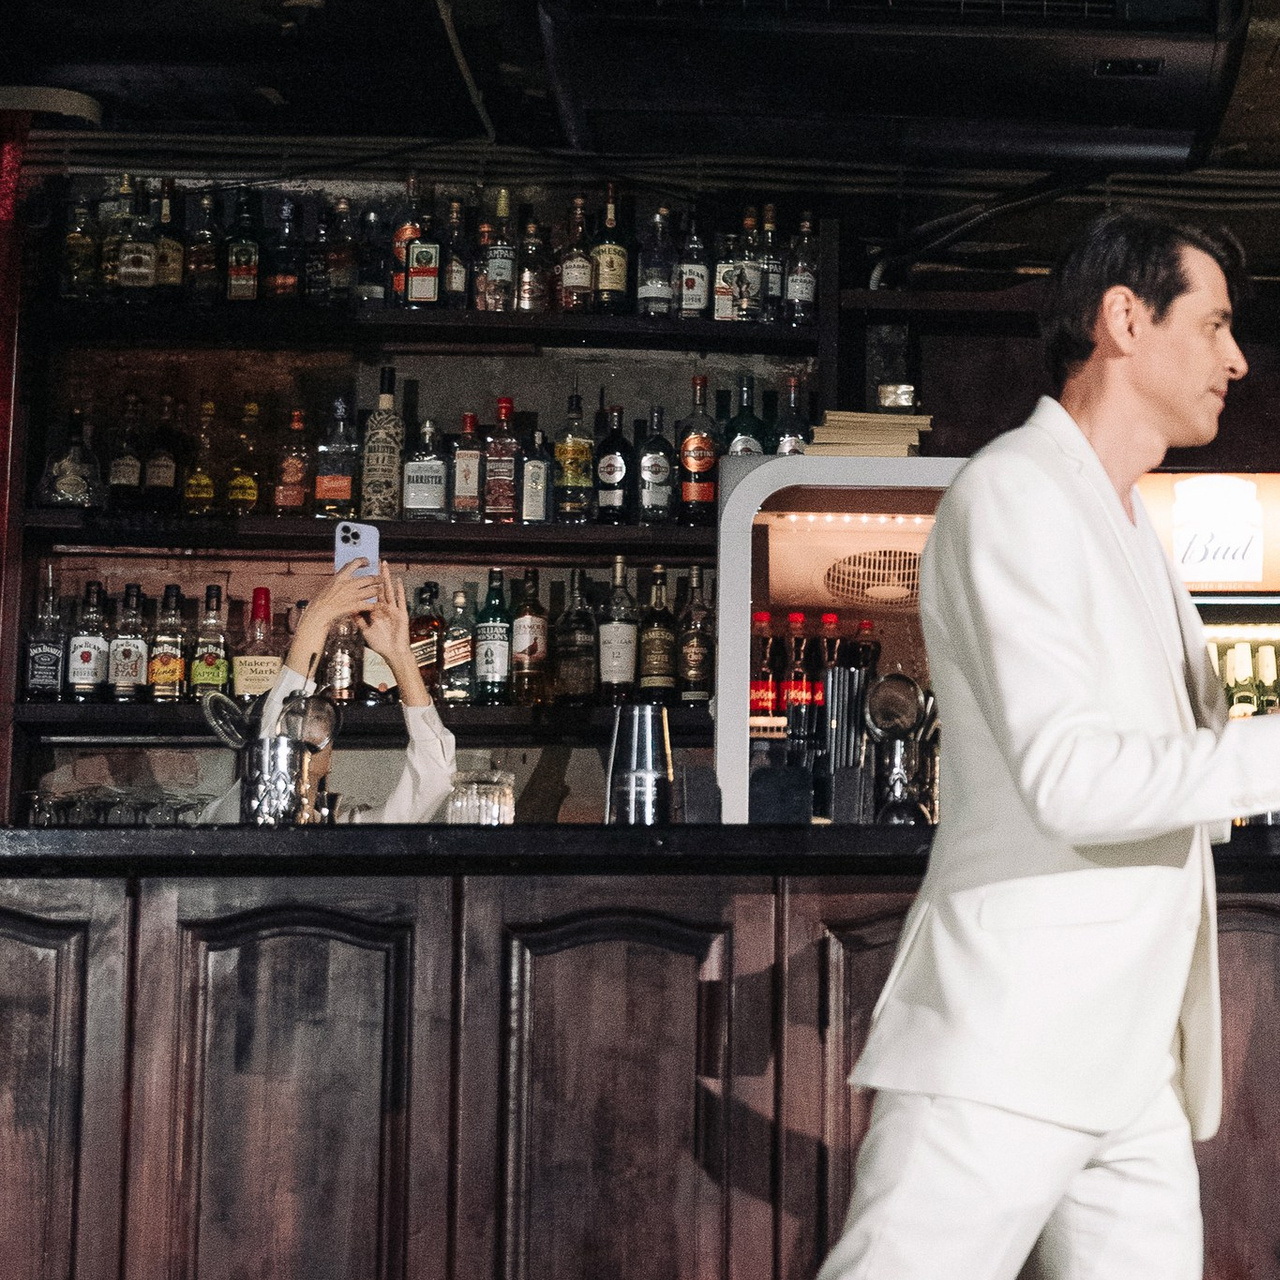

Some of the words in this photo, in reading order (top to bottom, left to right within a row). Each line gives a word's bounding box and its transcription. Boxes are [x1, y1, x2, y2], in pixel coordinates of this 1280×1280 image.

[407, 474, 442, 485] BARRISTER
[1180, 531, 1254, 564] Bud
[641, 630, 675, 642] JAMESON
[612, 651, 621, 659] 12
[239, 659, 277, 667] Maker's
[249, 667, 277, 675] Mark
